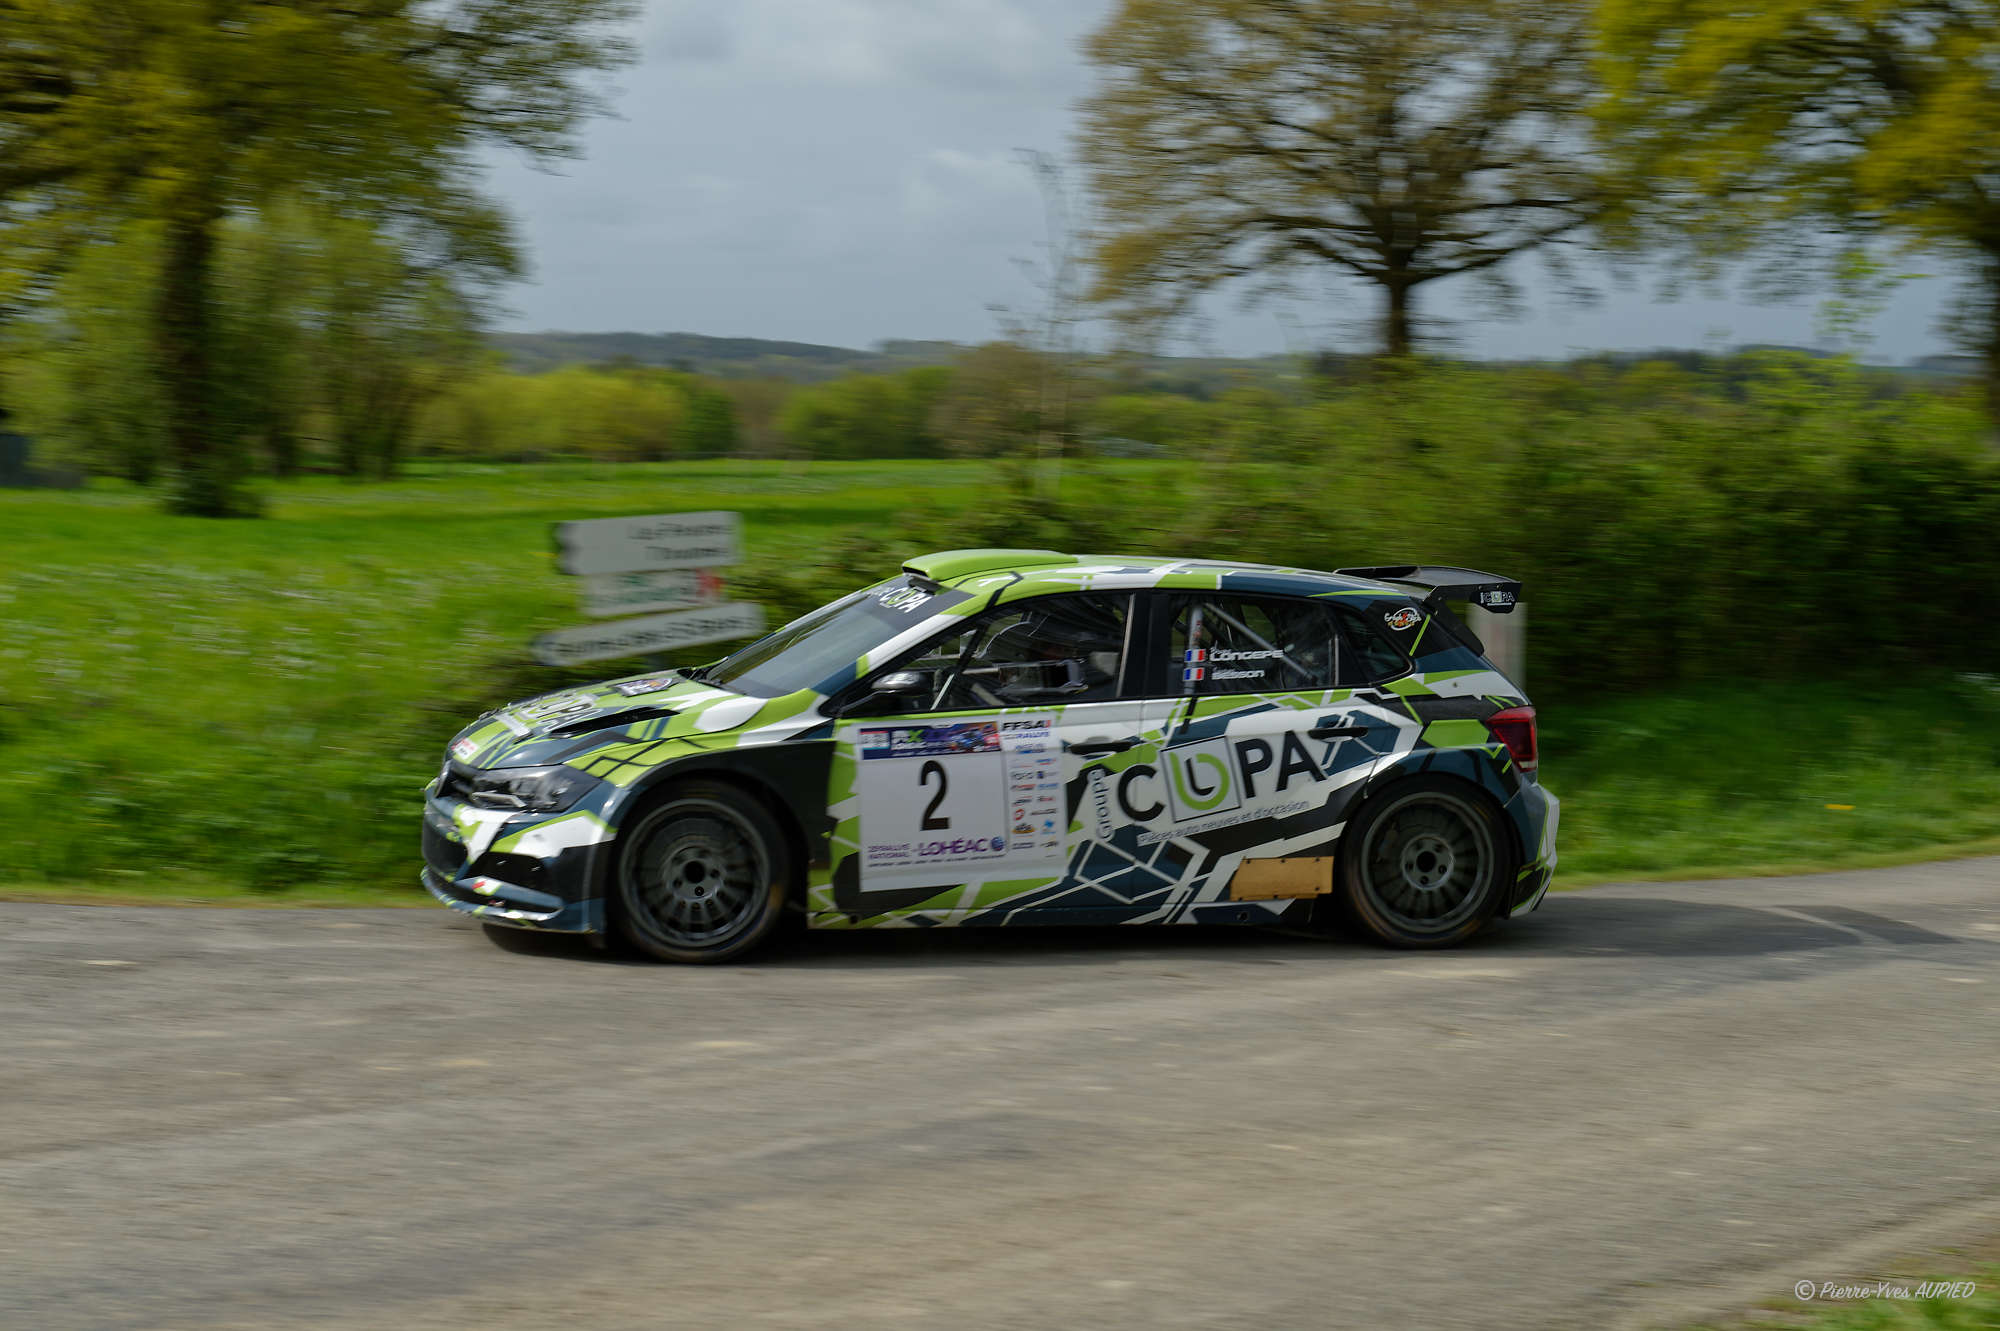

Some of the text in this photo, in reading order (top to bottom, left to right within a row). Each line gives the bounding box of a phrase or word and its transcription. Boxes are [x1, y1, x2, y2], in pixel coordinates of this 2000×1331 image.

[1001, 720, 1046, 731] FFSA
[919, 760, 950, 831] 2
[1090, 768, 1113, 839] Groupe
[1175, 824, 1199, 838] auto
[1200, 815, 1239, 833] neuves
[1240, 812, 1253, 824] et
[1254, 801, 1310, 820] d'occasion
[919, 837, 988, 856] LOHÉAC
